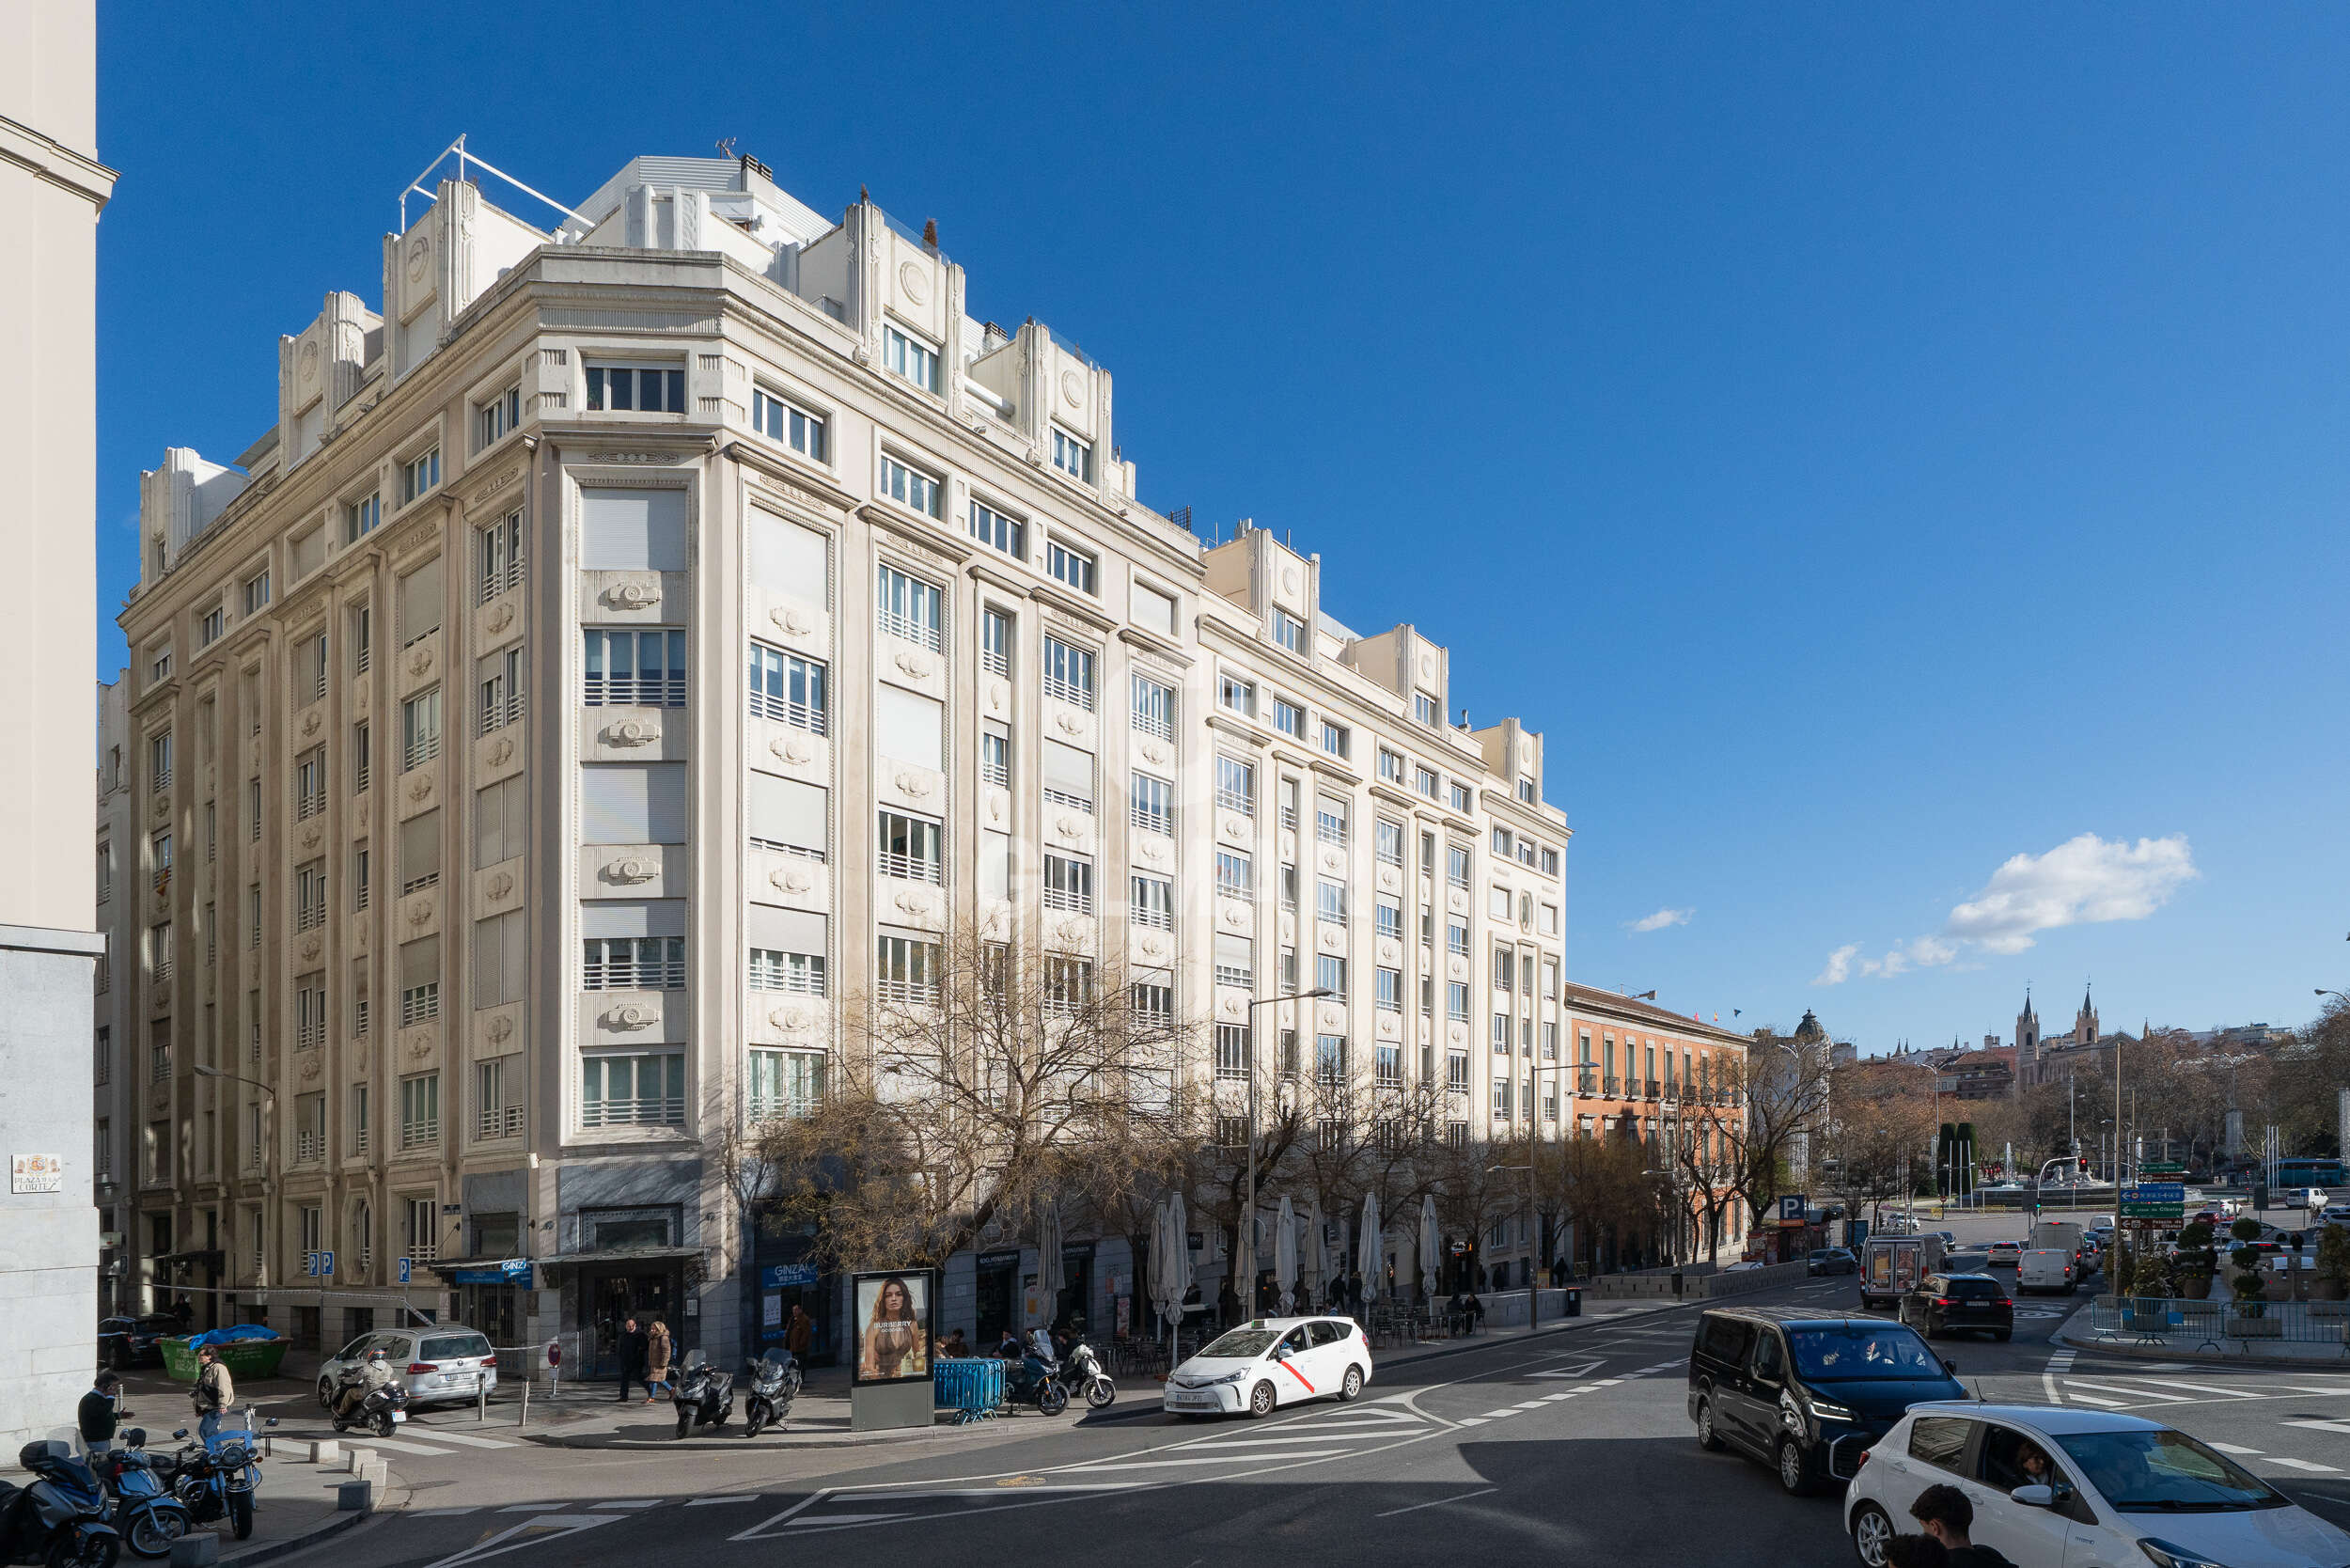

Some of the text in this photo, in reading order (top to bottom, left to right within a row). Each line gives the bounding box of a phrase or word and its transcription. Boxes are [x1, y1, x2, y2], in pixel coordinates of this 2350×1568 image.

[1783, 1199, 1799, 1218] P
[775, 1263, 806, 1277] GINZA
[873, 1320, 912, 1329] BURBERRY
